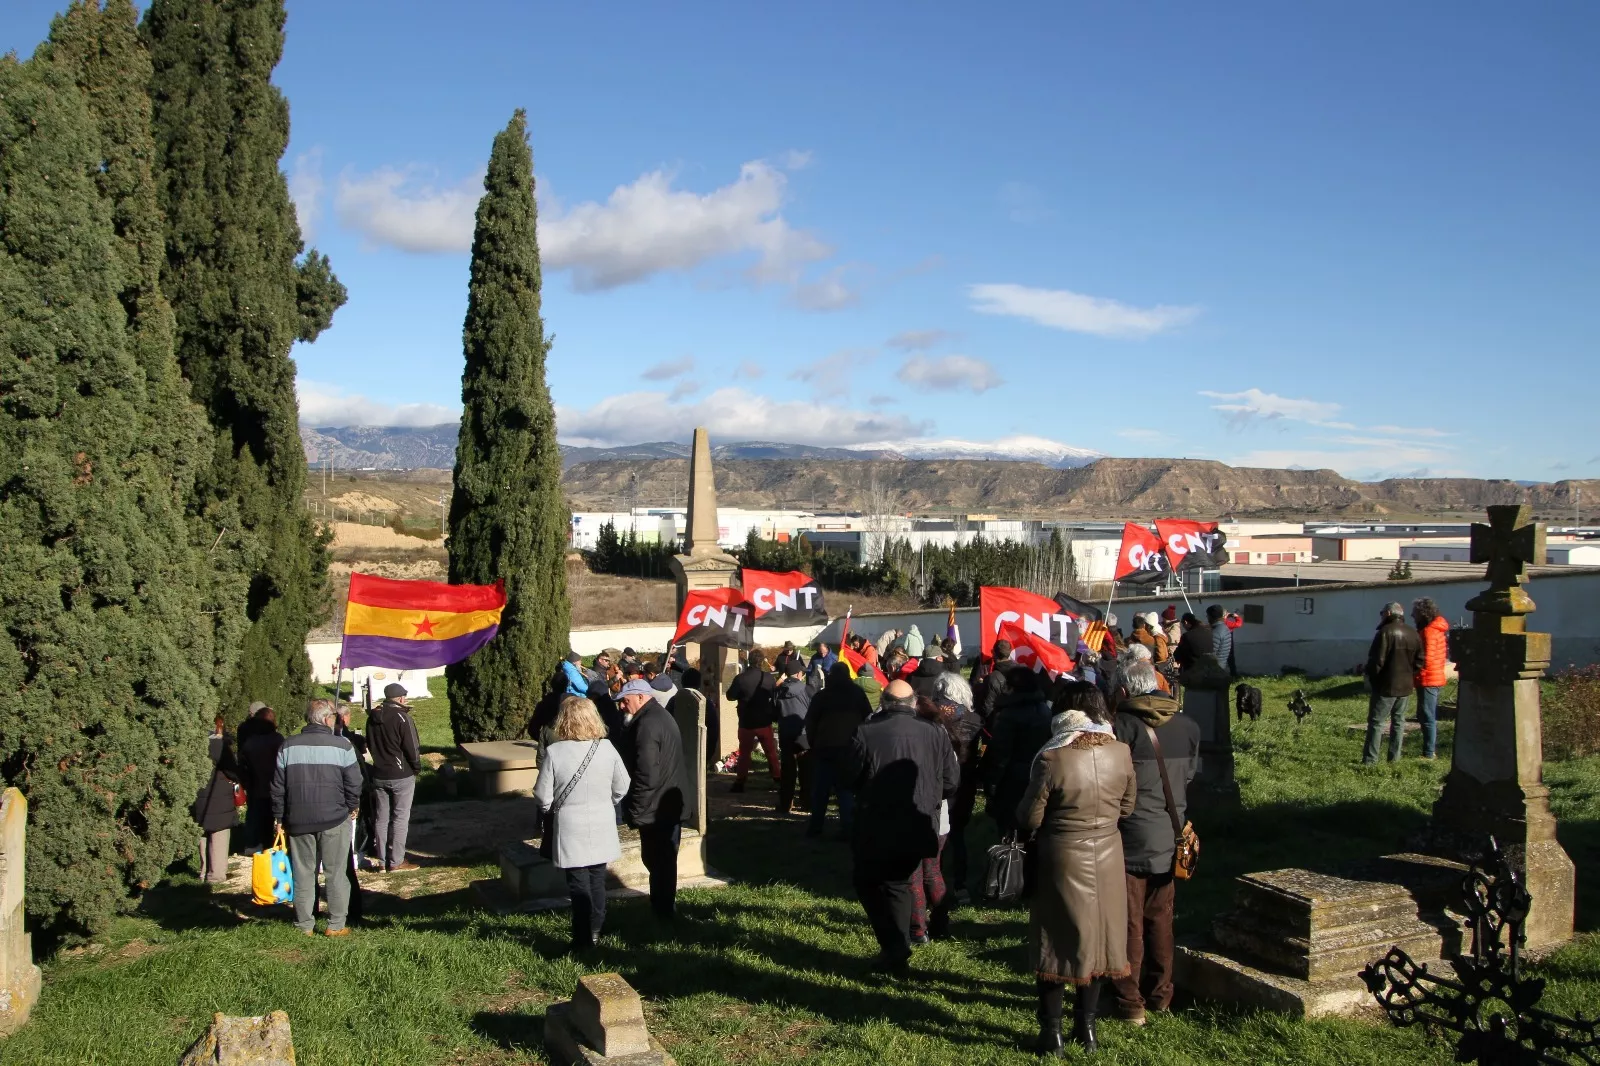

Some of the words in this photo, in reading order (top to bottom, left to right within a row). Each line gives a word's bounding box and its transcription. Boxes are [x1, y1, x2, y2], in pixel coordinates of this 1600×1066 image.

[1168, 532, 1219, 555] CNT
[1128, 544, 1163, 572] CNT
[753, 587, 817, 612] CNT
[686, 604, 749, 632] CNT
